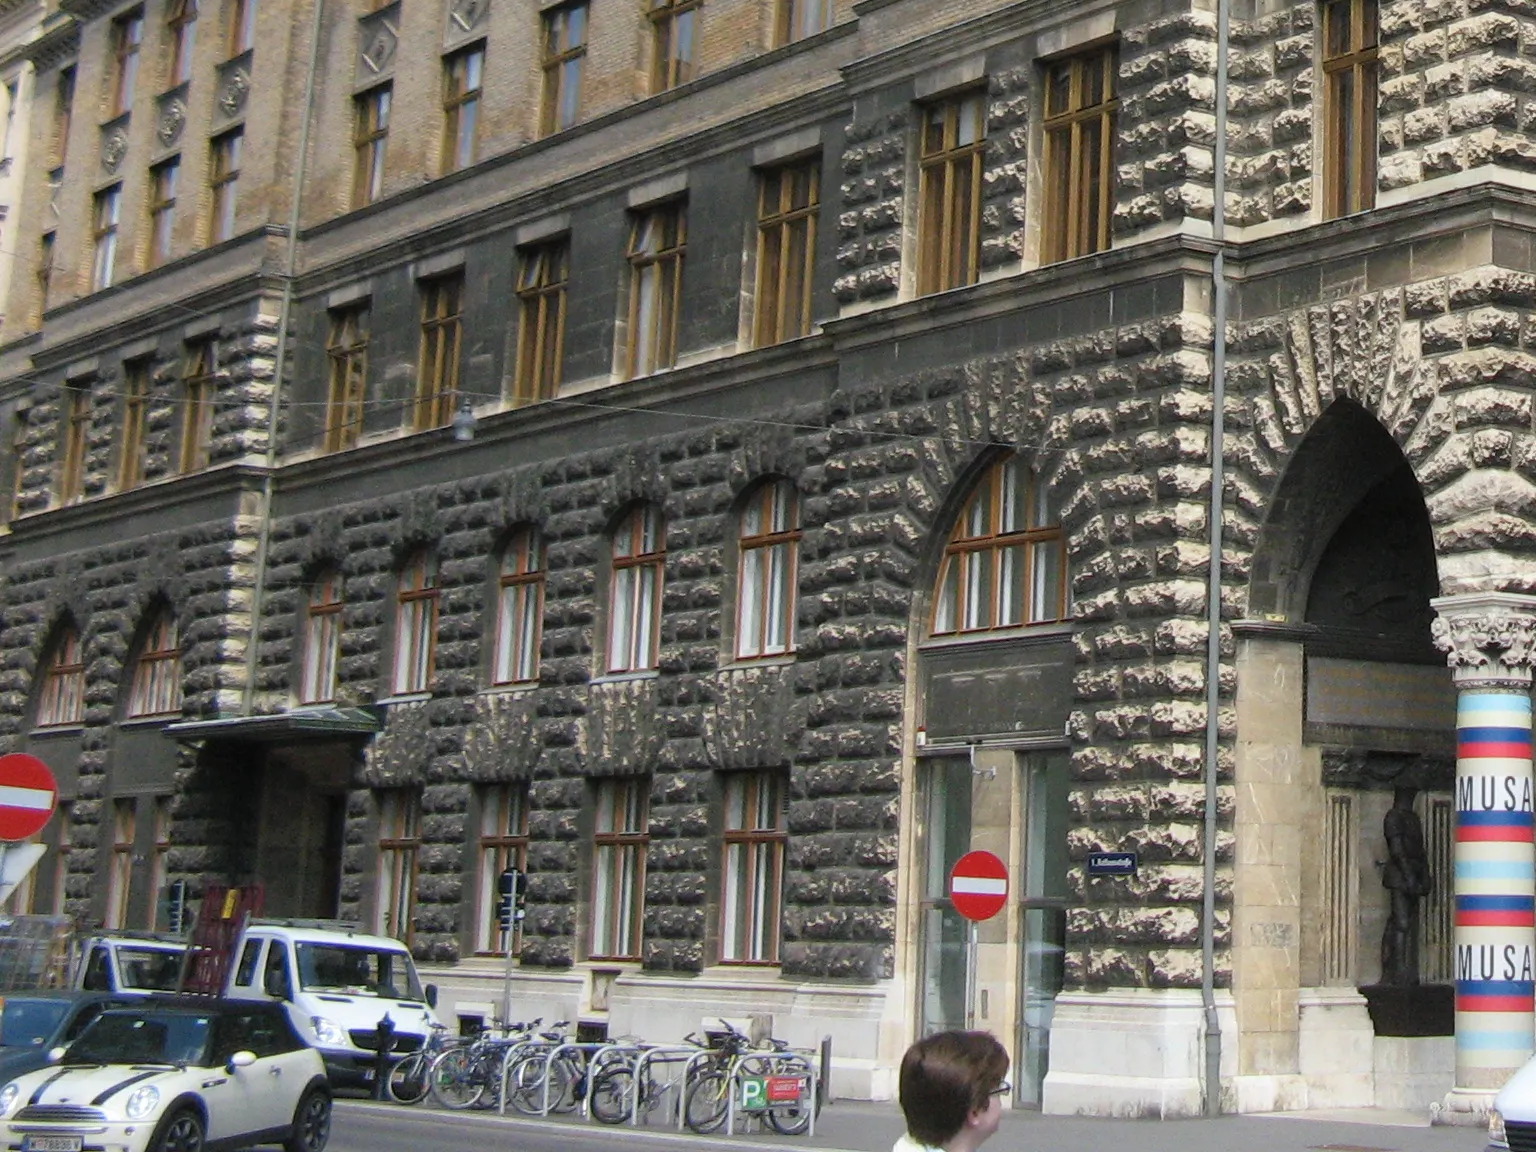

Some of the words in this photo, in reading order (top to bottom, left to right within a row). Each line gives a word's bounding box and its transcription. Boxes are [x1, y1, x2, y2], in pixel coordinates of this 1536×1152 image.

[1459, 775, 1532, 813] MUSA
[1458, 944, 1532, 981] MUSA
[743, 1080, 760, 1107] P
